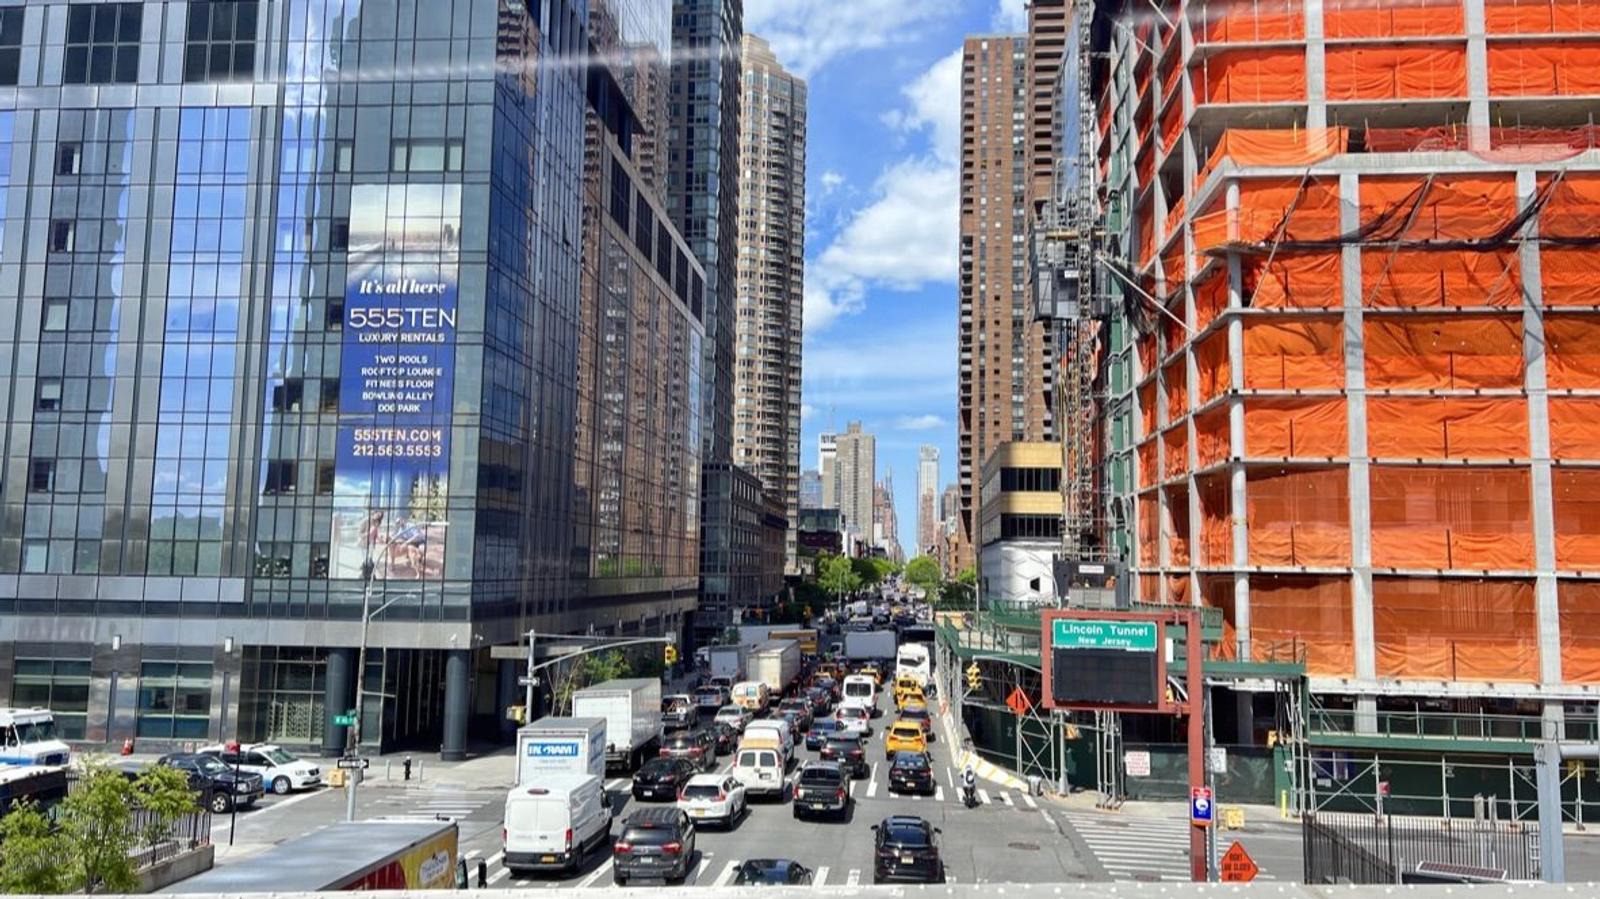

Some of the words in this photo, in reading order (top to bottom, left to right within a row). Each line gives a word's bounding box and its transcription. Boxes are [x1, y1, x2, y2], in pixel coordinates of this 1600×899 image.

[386, 278, 408, 294] all
[408, 279, 446, 294] here
[348, 307, 457, 328] 555TEN
[359, 332, 399, 343] LUXURY
[400, 332, 446, 343] RENTALS
[374, 354, 396, 365] TWO
[398, 354, 429, 365] POOLS
[361, 366, 406, 377] ROOFTOP
[365, 378, 405, 389] FITNESS
[405, 378, 435, 389] FLOOR
[362, 390, 404, 401] BOWLING
[404, 390, 435, 401] ALLEY
[396, 403, 421, 413] PARK
[353, 428, 442, 442] 555TEN.COM
[1062, 623, 1104, 635] Lincoln
[1110, 625, 1148, 637] Tunnel
[1078, 636, 1097, 645] New
[1101, 637, 1132, 647] Jersey
